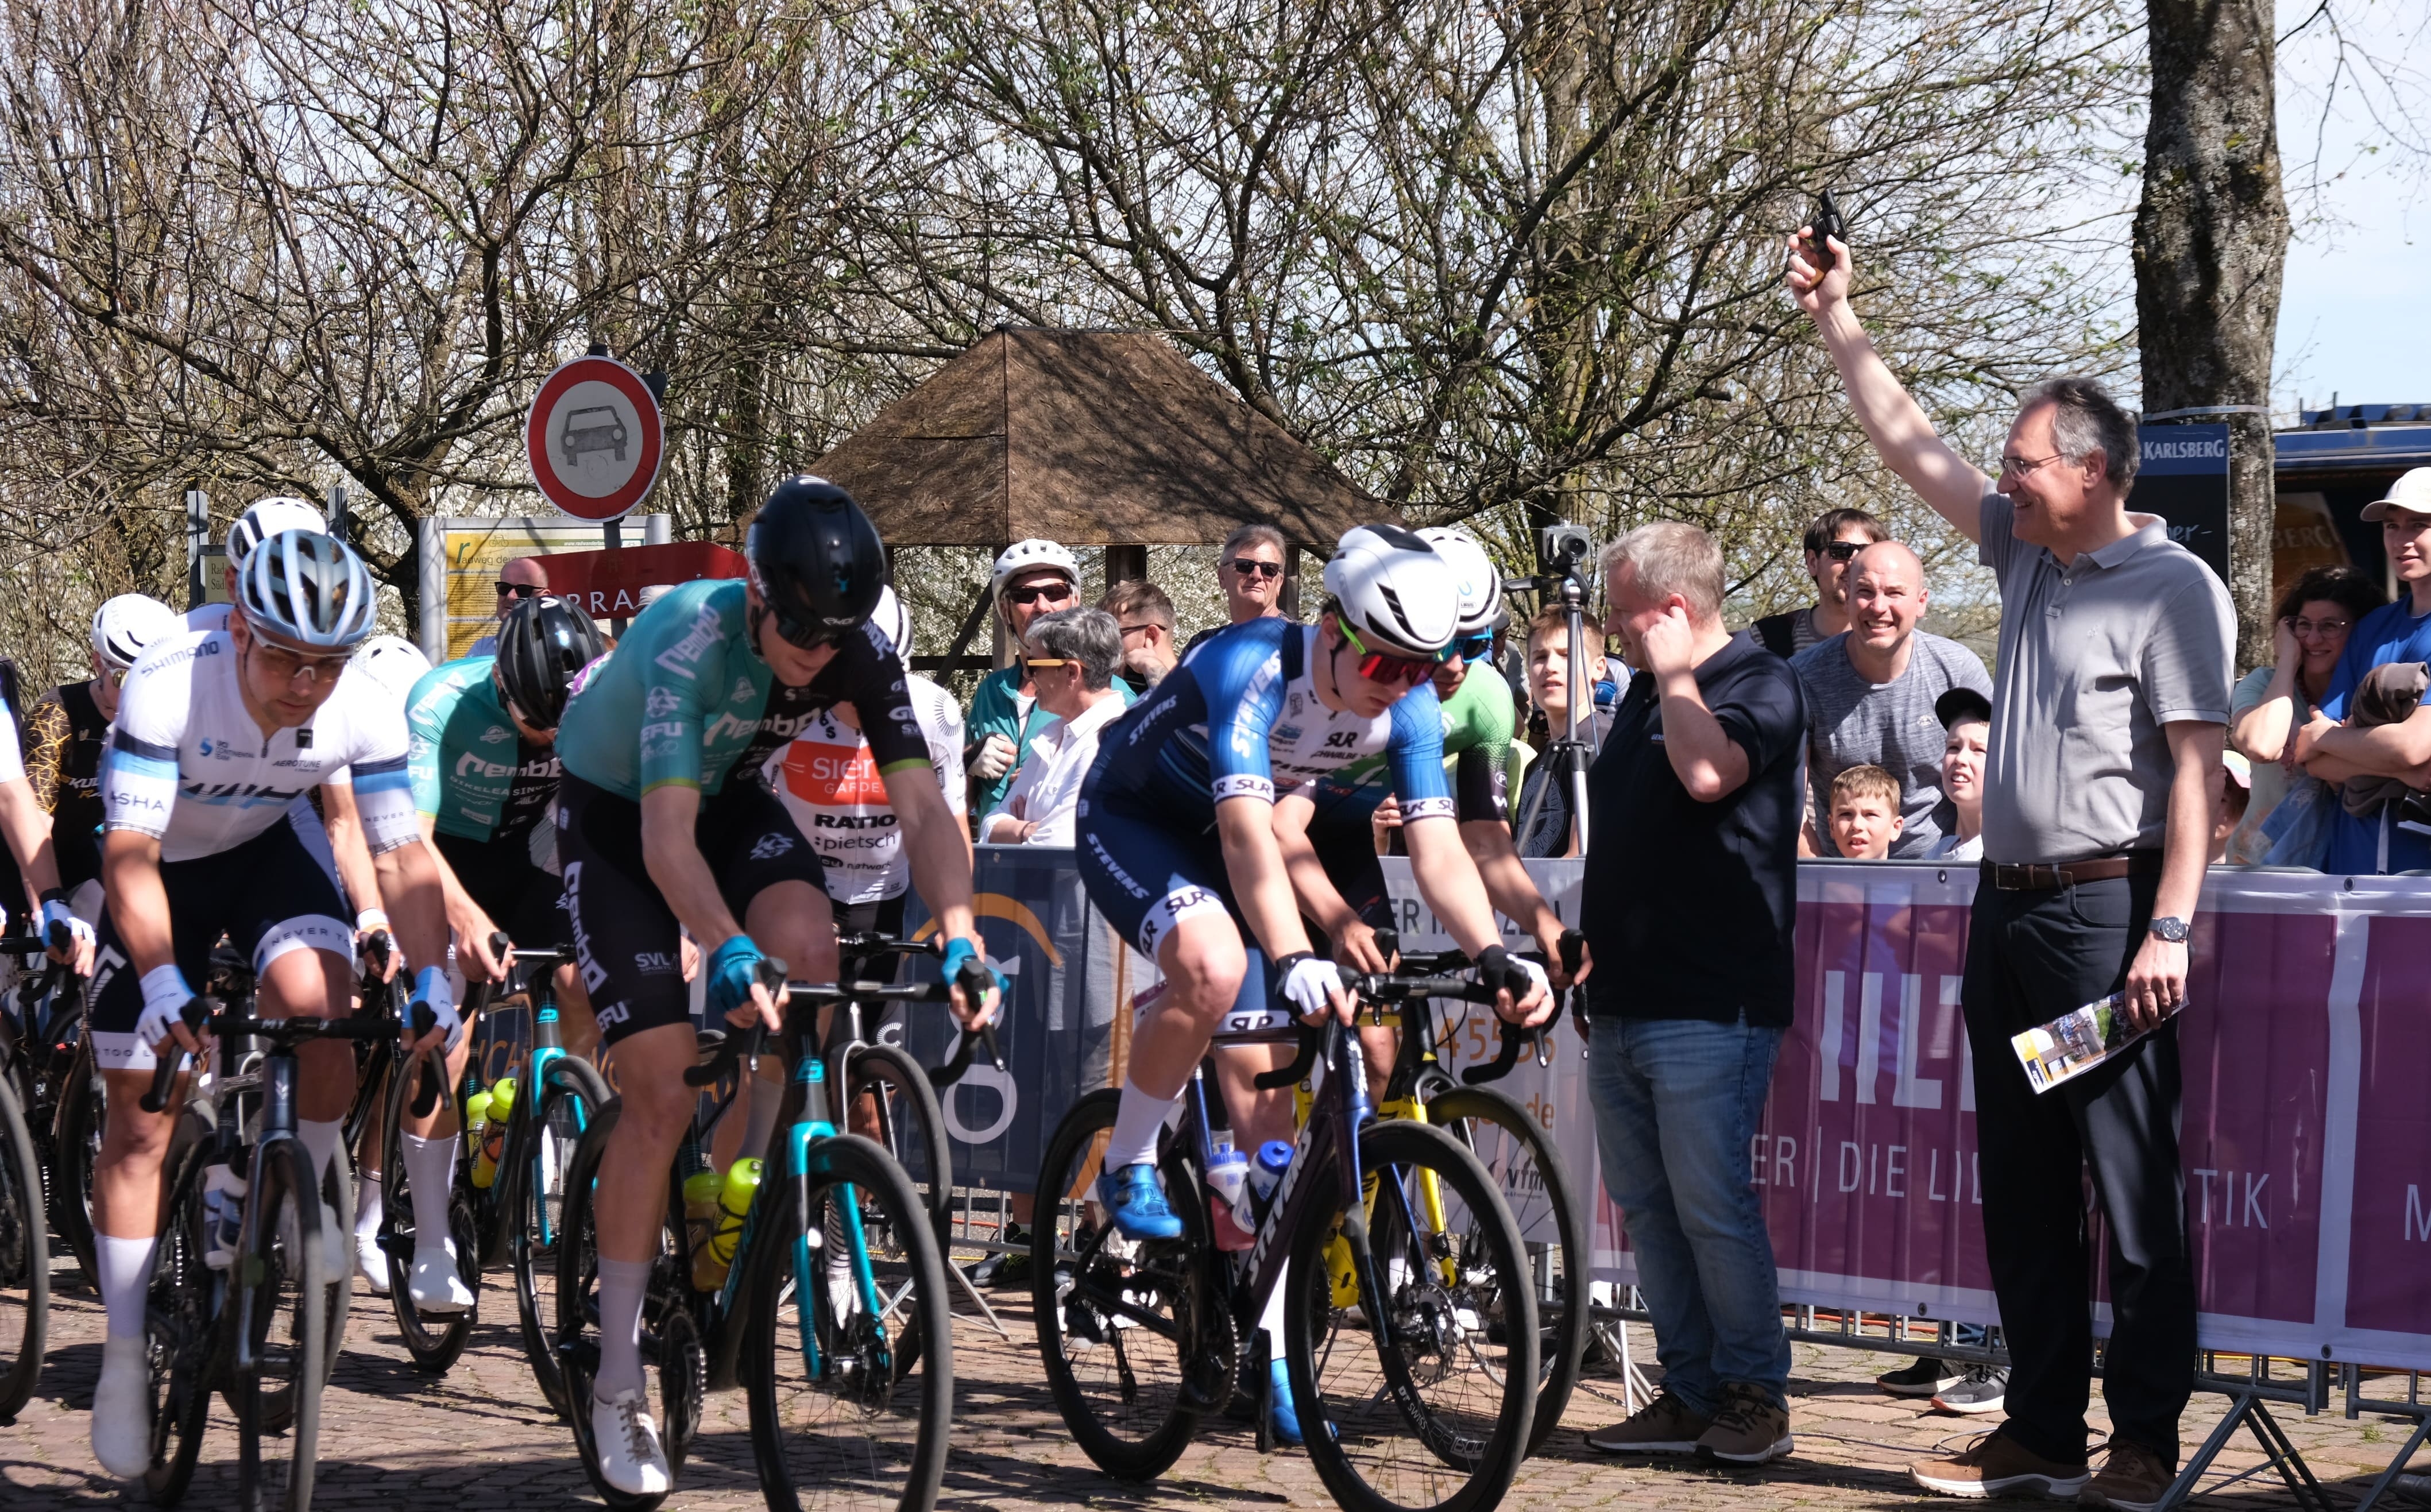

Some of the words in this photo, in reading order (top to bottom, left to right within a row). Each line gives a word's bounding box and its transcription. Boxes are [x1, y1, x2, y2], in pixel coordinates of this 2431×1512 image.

[2144, 439, 2225, 459] KARLSBERG
[140, 640, 219, 678] SHIMANO
[1129, 695, 1177, 746] STEVENS
[273, 760, 321, 768] AEROTUNE
[825, 782, 886, 794] GARDE
[365, 811, 404, 823] NEVER
[814, 814, 897, 829] RATIO
[847, 861, 892, 871] network
[1086, 833, 1150, 899] STEVENS
[272, 927, 328, 946] NEVER
[635, 953, 671, 968] SVL
[1838, 1140, 1907, 1198] DIE
[1249, 1130, 1313, 1287] STEVENS
[1407, 1402, 1428, 1430] SWISS
